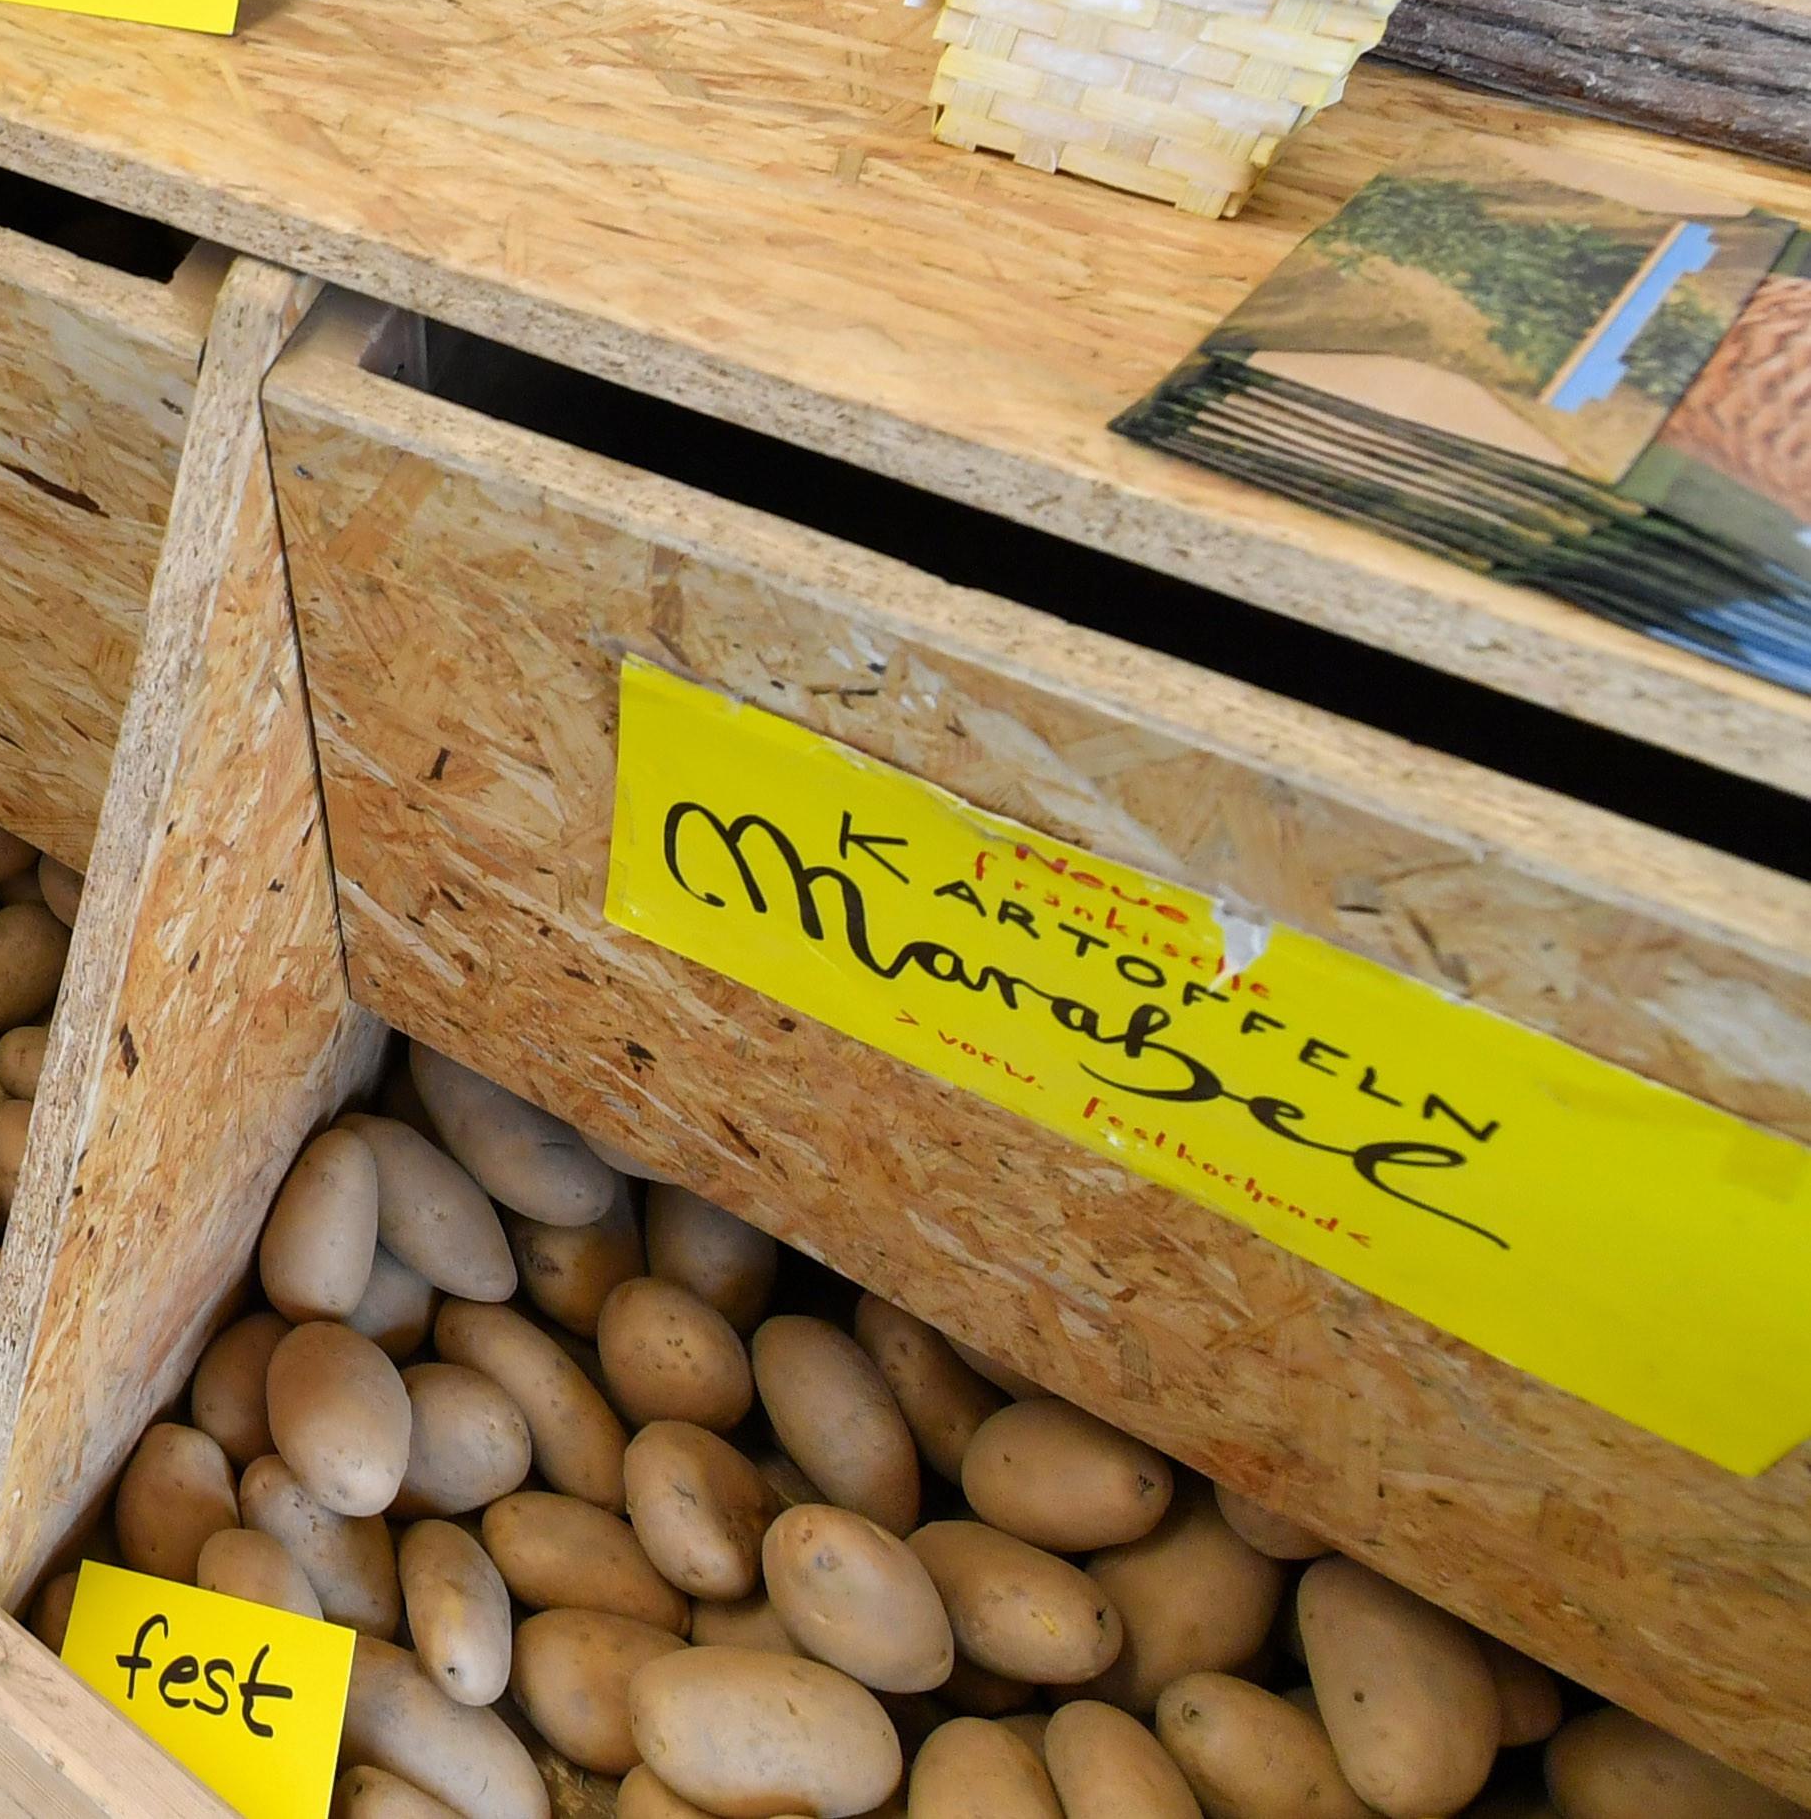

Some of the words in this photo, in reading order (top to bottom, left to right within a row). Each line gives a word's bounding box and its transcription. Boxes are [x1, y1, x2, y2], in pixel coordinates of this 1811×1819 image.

[838, 809, 1501, 1143] KARTOFFELN
[1015, 842, 1191, 925] Neue
[663, 800, 1512, 1249] Marabel
[115, 1613, 294, 1739] fest
